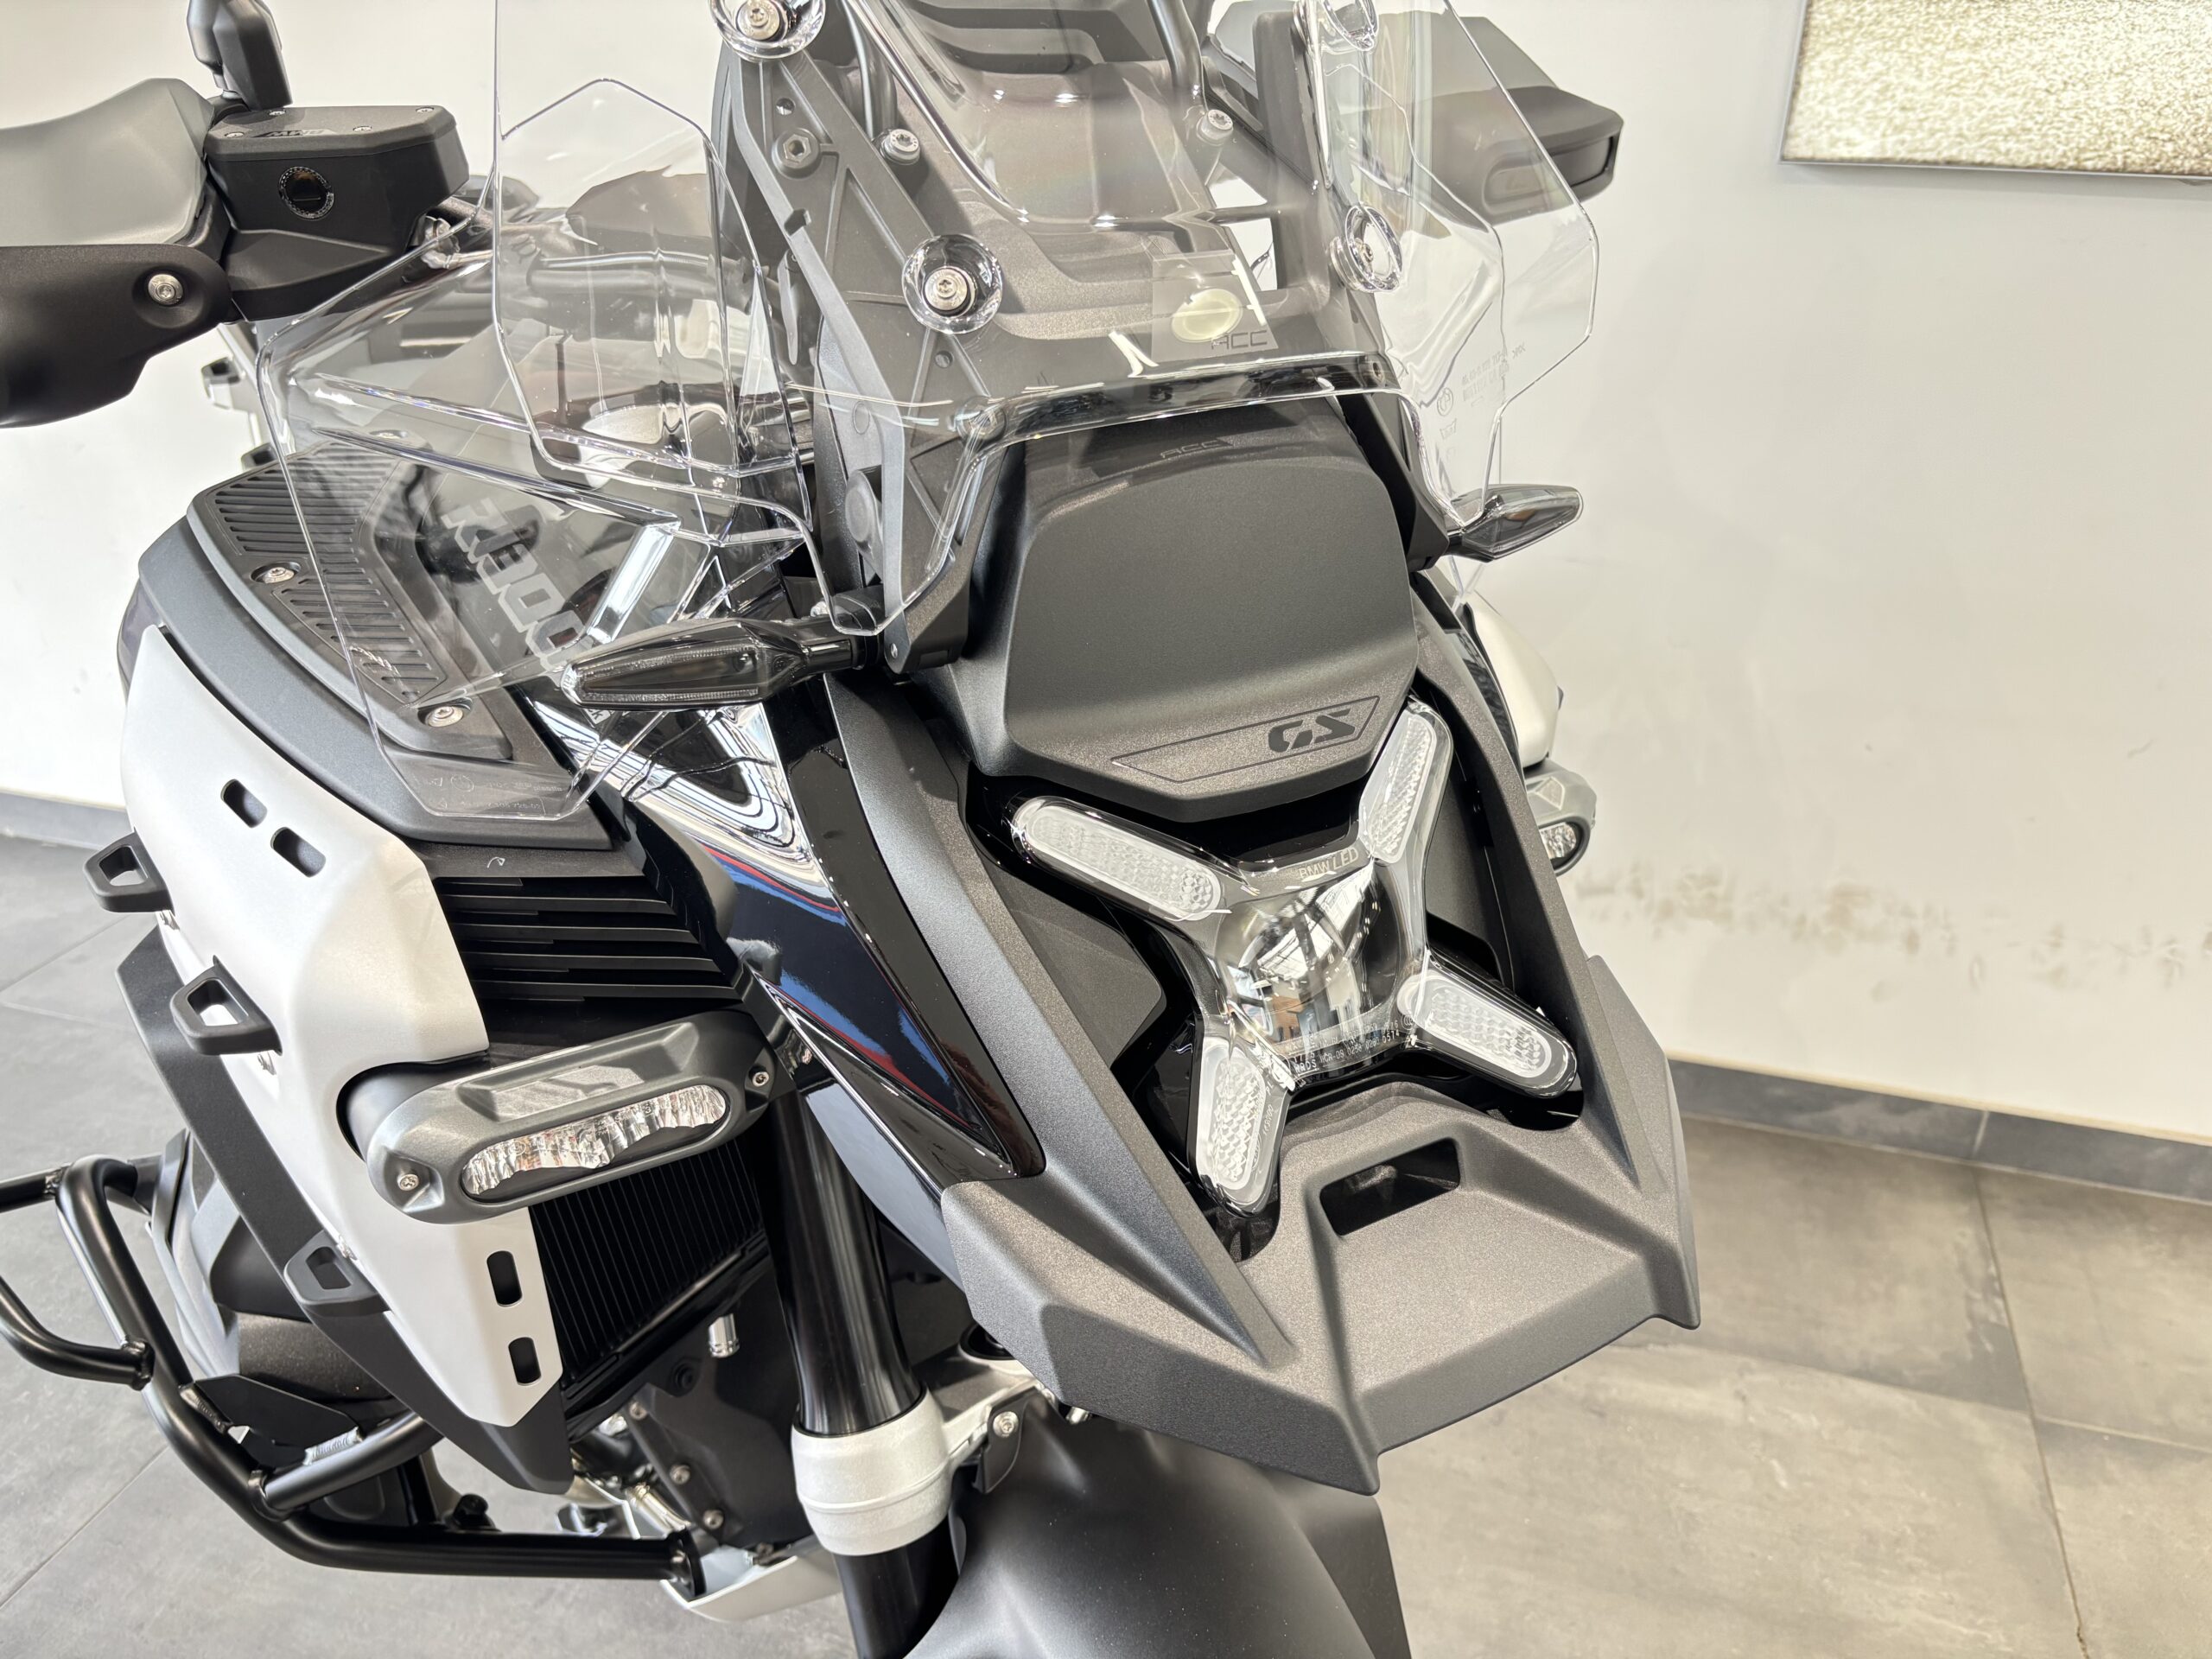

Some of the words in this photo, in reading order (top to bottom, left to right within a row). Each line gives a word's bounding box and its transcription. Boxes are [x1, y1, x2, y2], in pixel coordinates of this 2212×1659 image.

[1211, 330, 1268, 349] ACC
[1268, 709, 1356, 753] GS
[1298, 859, 1330, 879] BMW
[1332, 847, 1359, 870] LED
